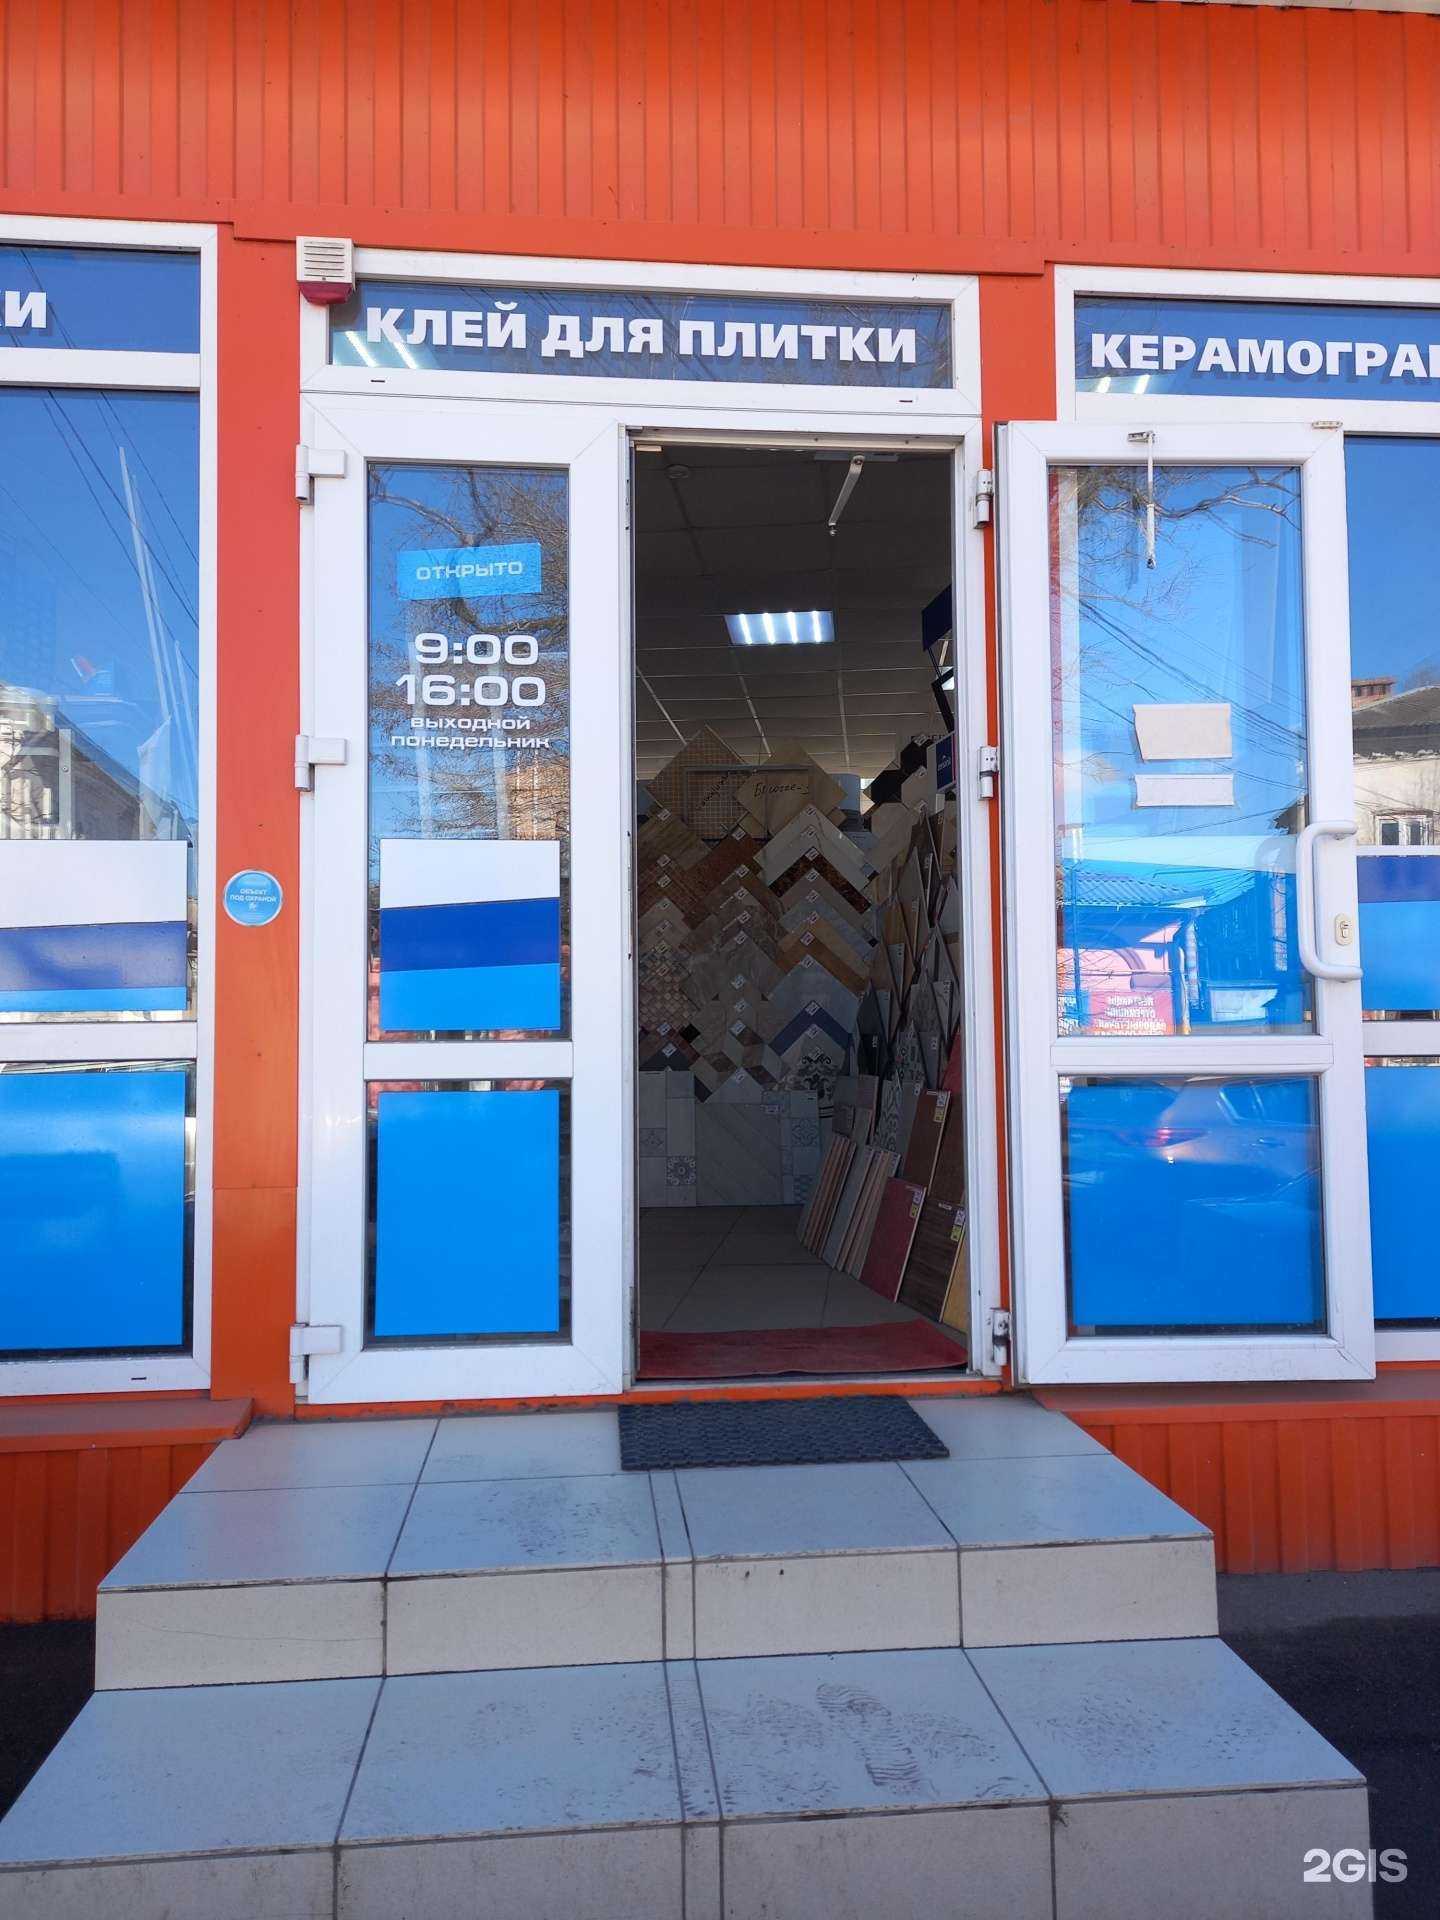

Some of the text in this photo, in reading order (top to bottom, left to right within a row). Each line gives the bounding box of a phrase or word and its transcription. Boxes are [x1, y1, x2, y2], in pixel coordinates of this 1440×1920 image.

[0, 290, 47, 328] И
[366, 301, 916, 363] КЛЕЙ ДЛЯ ПЛИТКИ
[416, 561, 523, 580] ОТКРЫТО
[414, 632, 539, 665] 9:00
[395, 674, 546, 707] 16:00
